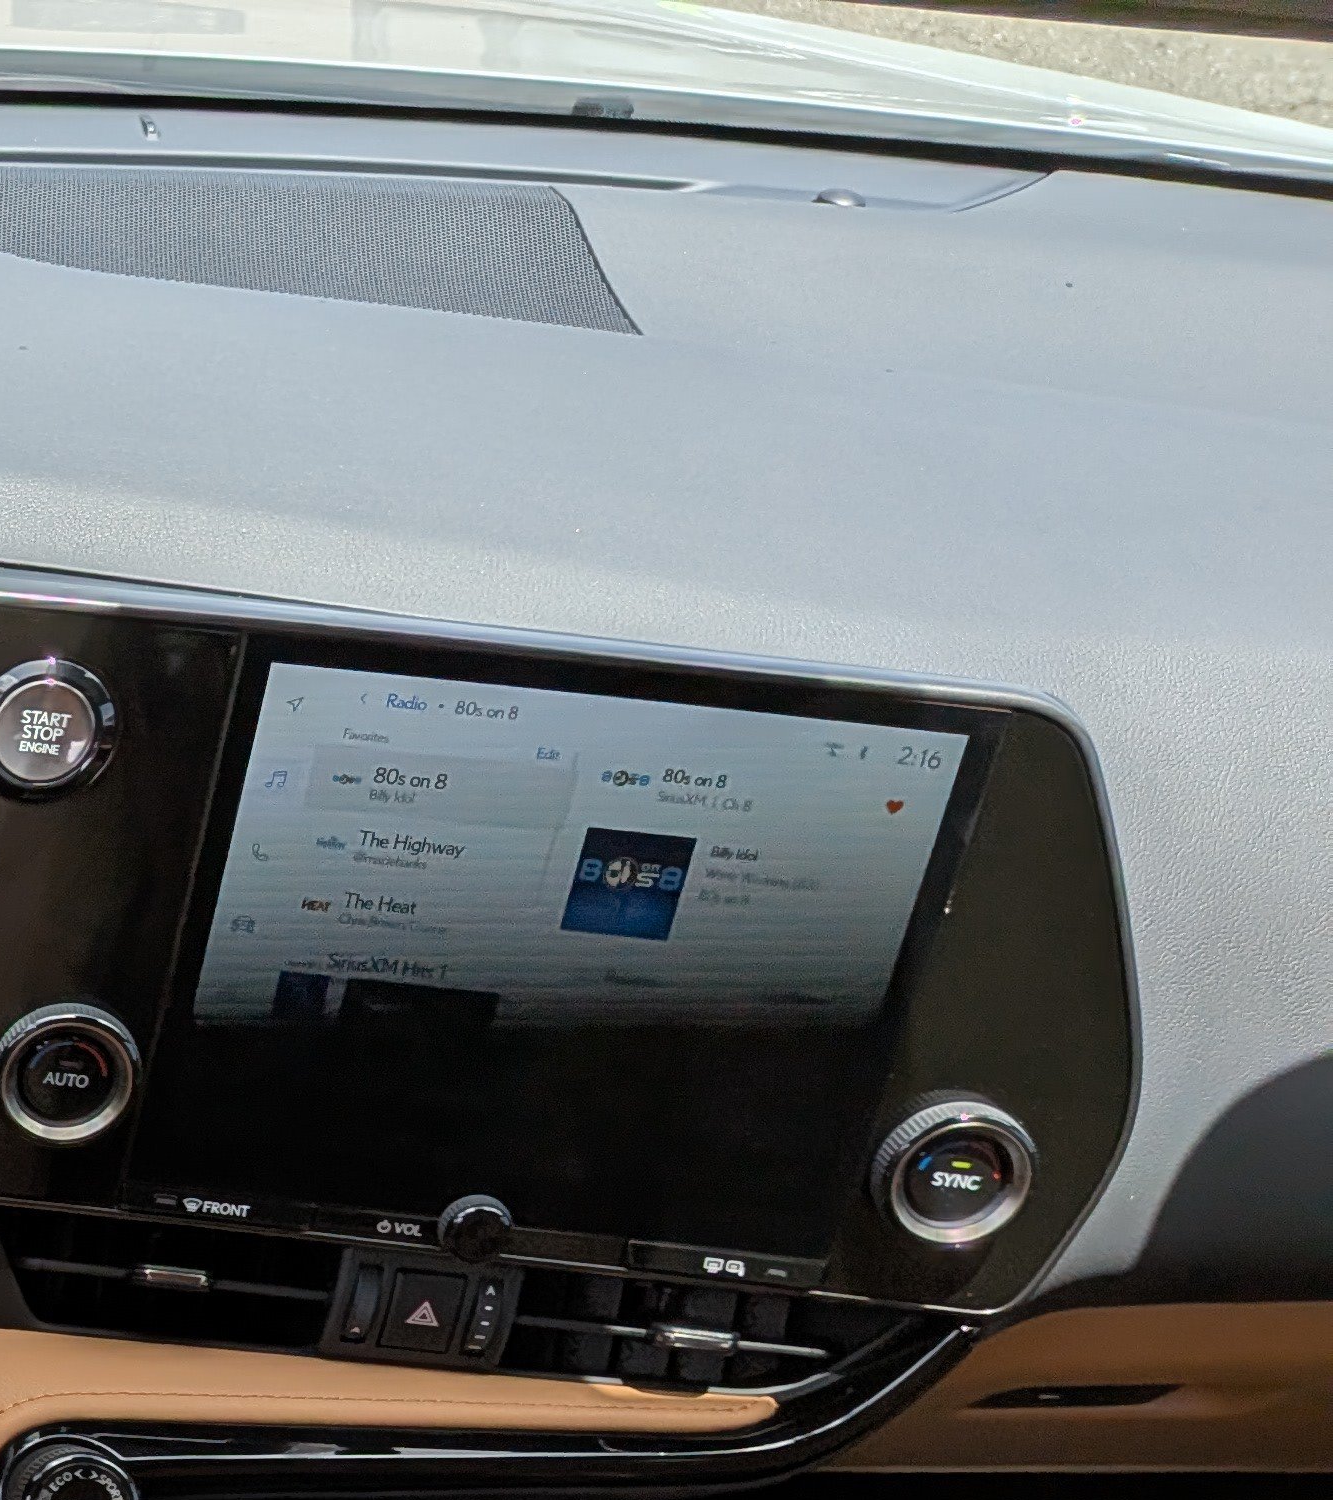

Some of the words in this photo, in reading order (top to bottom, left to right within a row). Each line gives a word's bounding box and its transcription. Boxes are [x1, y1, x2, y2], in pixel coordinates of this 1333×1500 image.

[386, 693, 428, 711] Radio
[454, 700, 483, 717] 80s
[486, 705, 504, 719] on
[508, 704, 519, 720] 8
[20, 709, 73, 728] START
[21, 725, 65, 742] STOP
[18, 740, 61, 756] ENGINE
[896, 745, 942, 770] 2:16
[373, 766, 407, 786] 80s
[409, 775, 431, 789] on
[434, 773, 448, 790] 8
[662, 768, 691, 786] 80s
[694, 776, 713, 788] on
[715, 774, 728, 789] 8
[359, 829, 390, 849] The
[392, 833, 466, 860] Highway
[345, 891, 374, 911] The
[378, 895, 417, 915] Heat
[42, 1071, 89, 1089] AUTO
[930, 1171, 984, 1192] SYNC
[201, 1200, 252, 1218] FRONT
[394, 1221, 423, 1237] VOL
[49, 1472, 73, 1492] ECO
